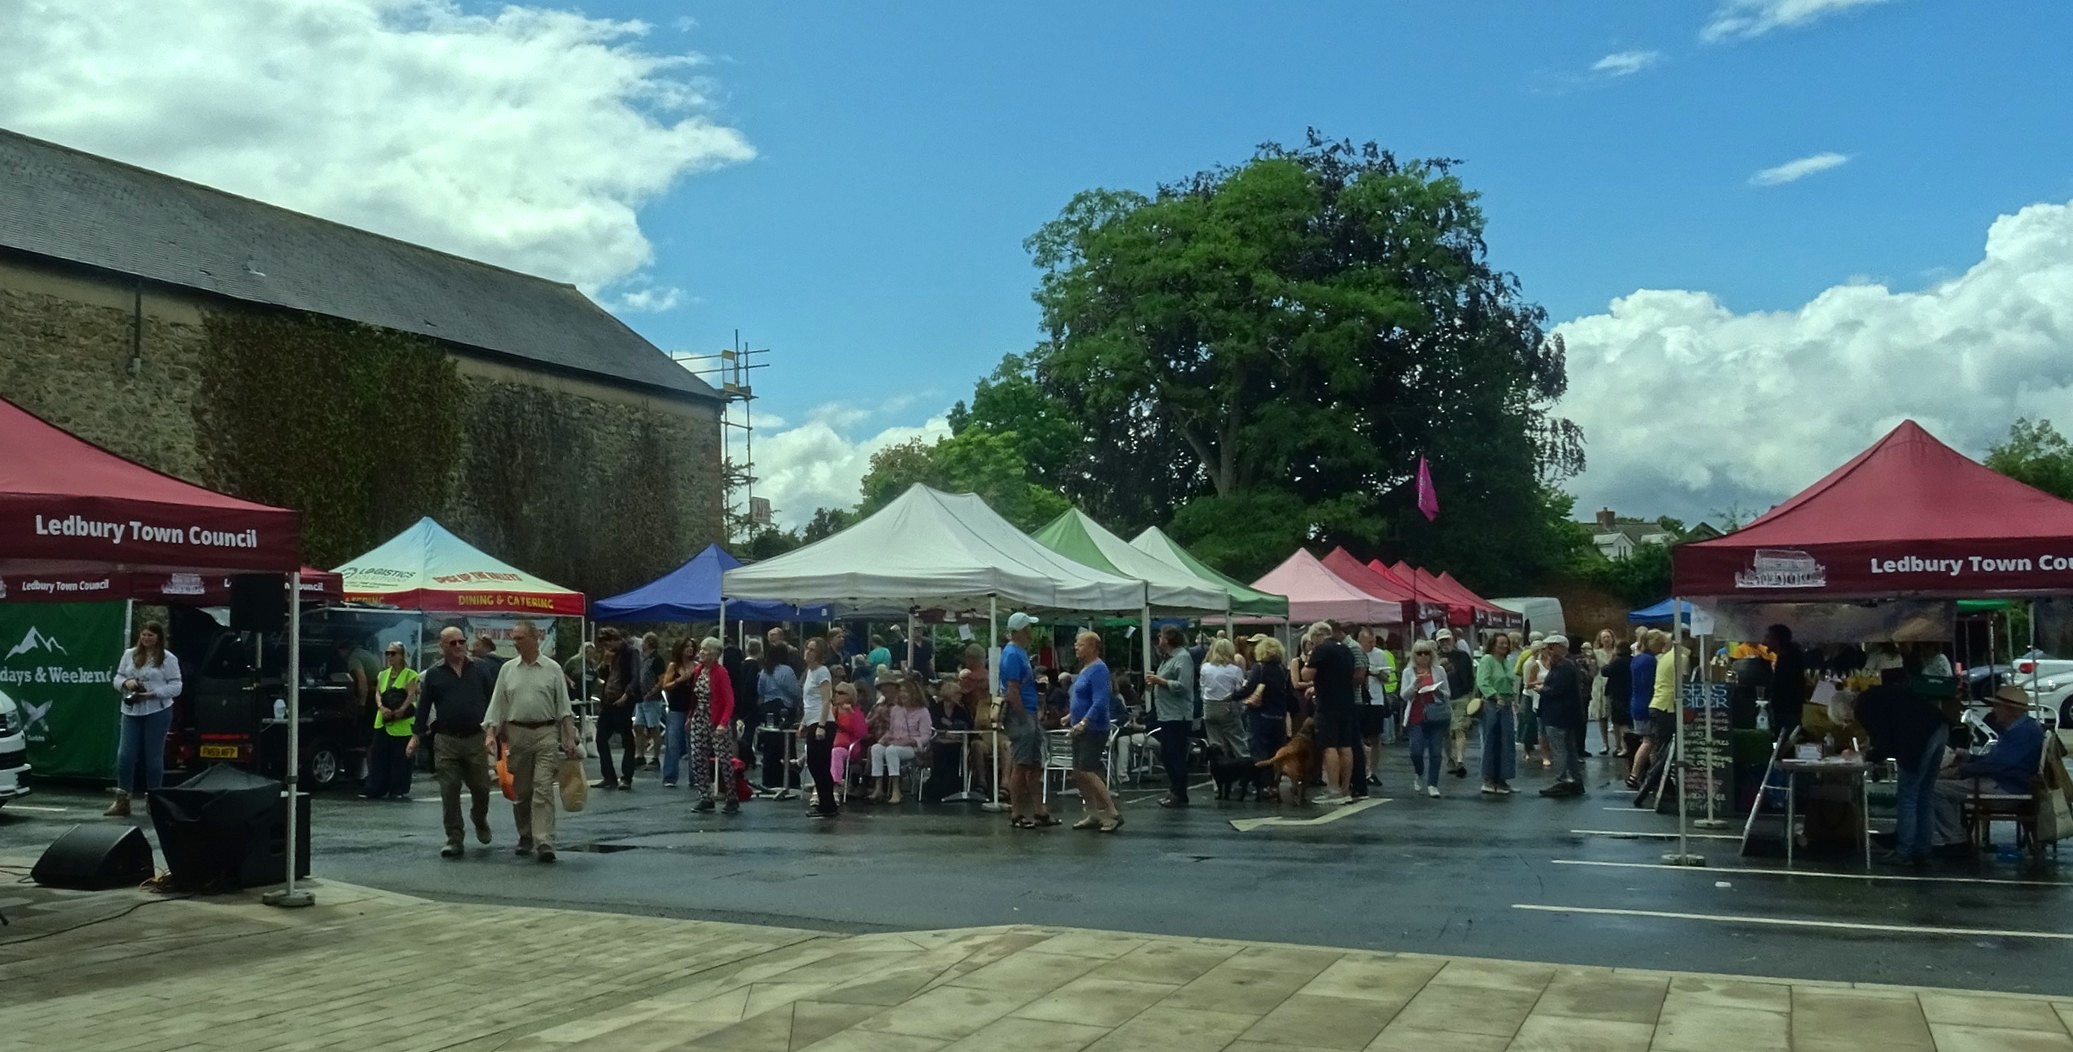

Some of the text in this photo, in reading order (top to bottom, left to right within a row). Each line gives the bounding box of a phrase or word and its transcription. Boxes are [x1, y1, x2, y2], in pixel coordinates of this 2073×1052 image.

[35, 514, 258, 548] Ledbury Town Council
[358, 567, 417, 579] LOGISTICS
[1870, 555, 1964, 577] Ledbury
[1968, 556, 2032, 572] Town
[21, 579, 110, 594] Ledbury Town Council
[298, 582, 324, 592] ouncil
[344, 596, 385, 606] ATERING
[458, 595, 554, 609] DINING & CATERING
[35, 666, 47, 683] &
